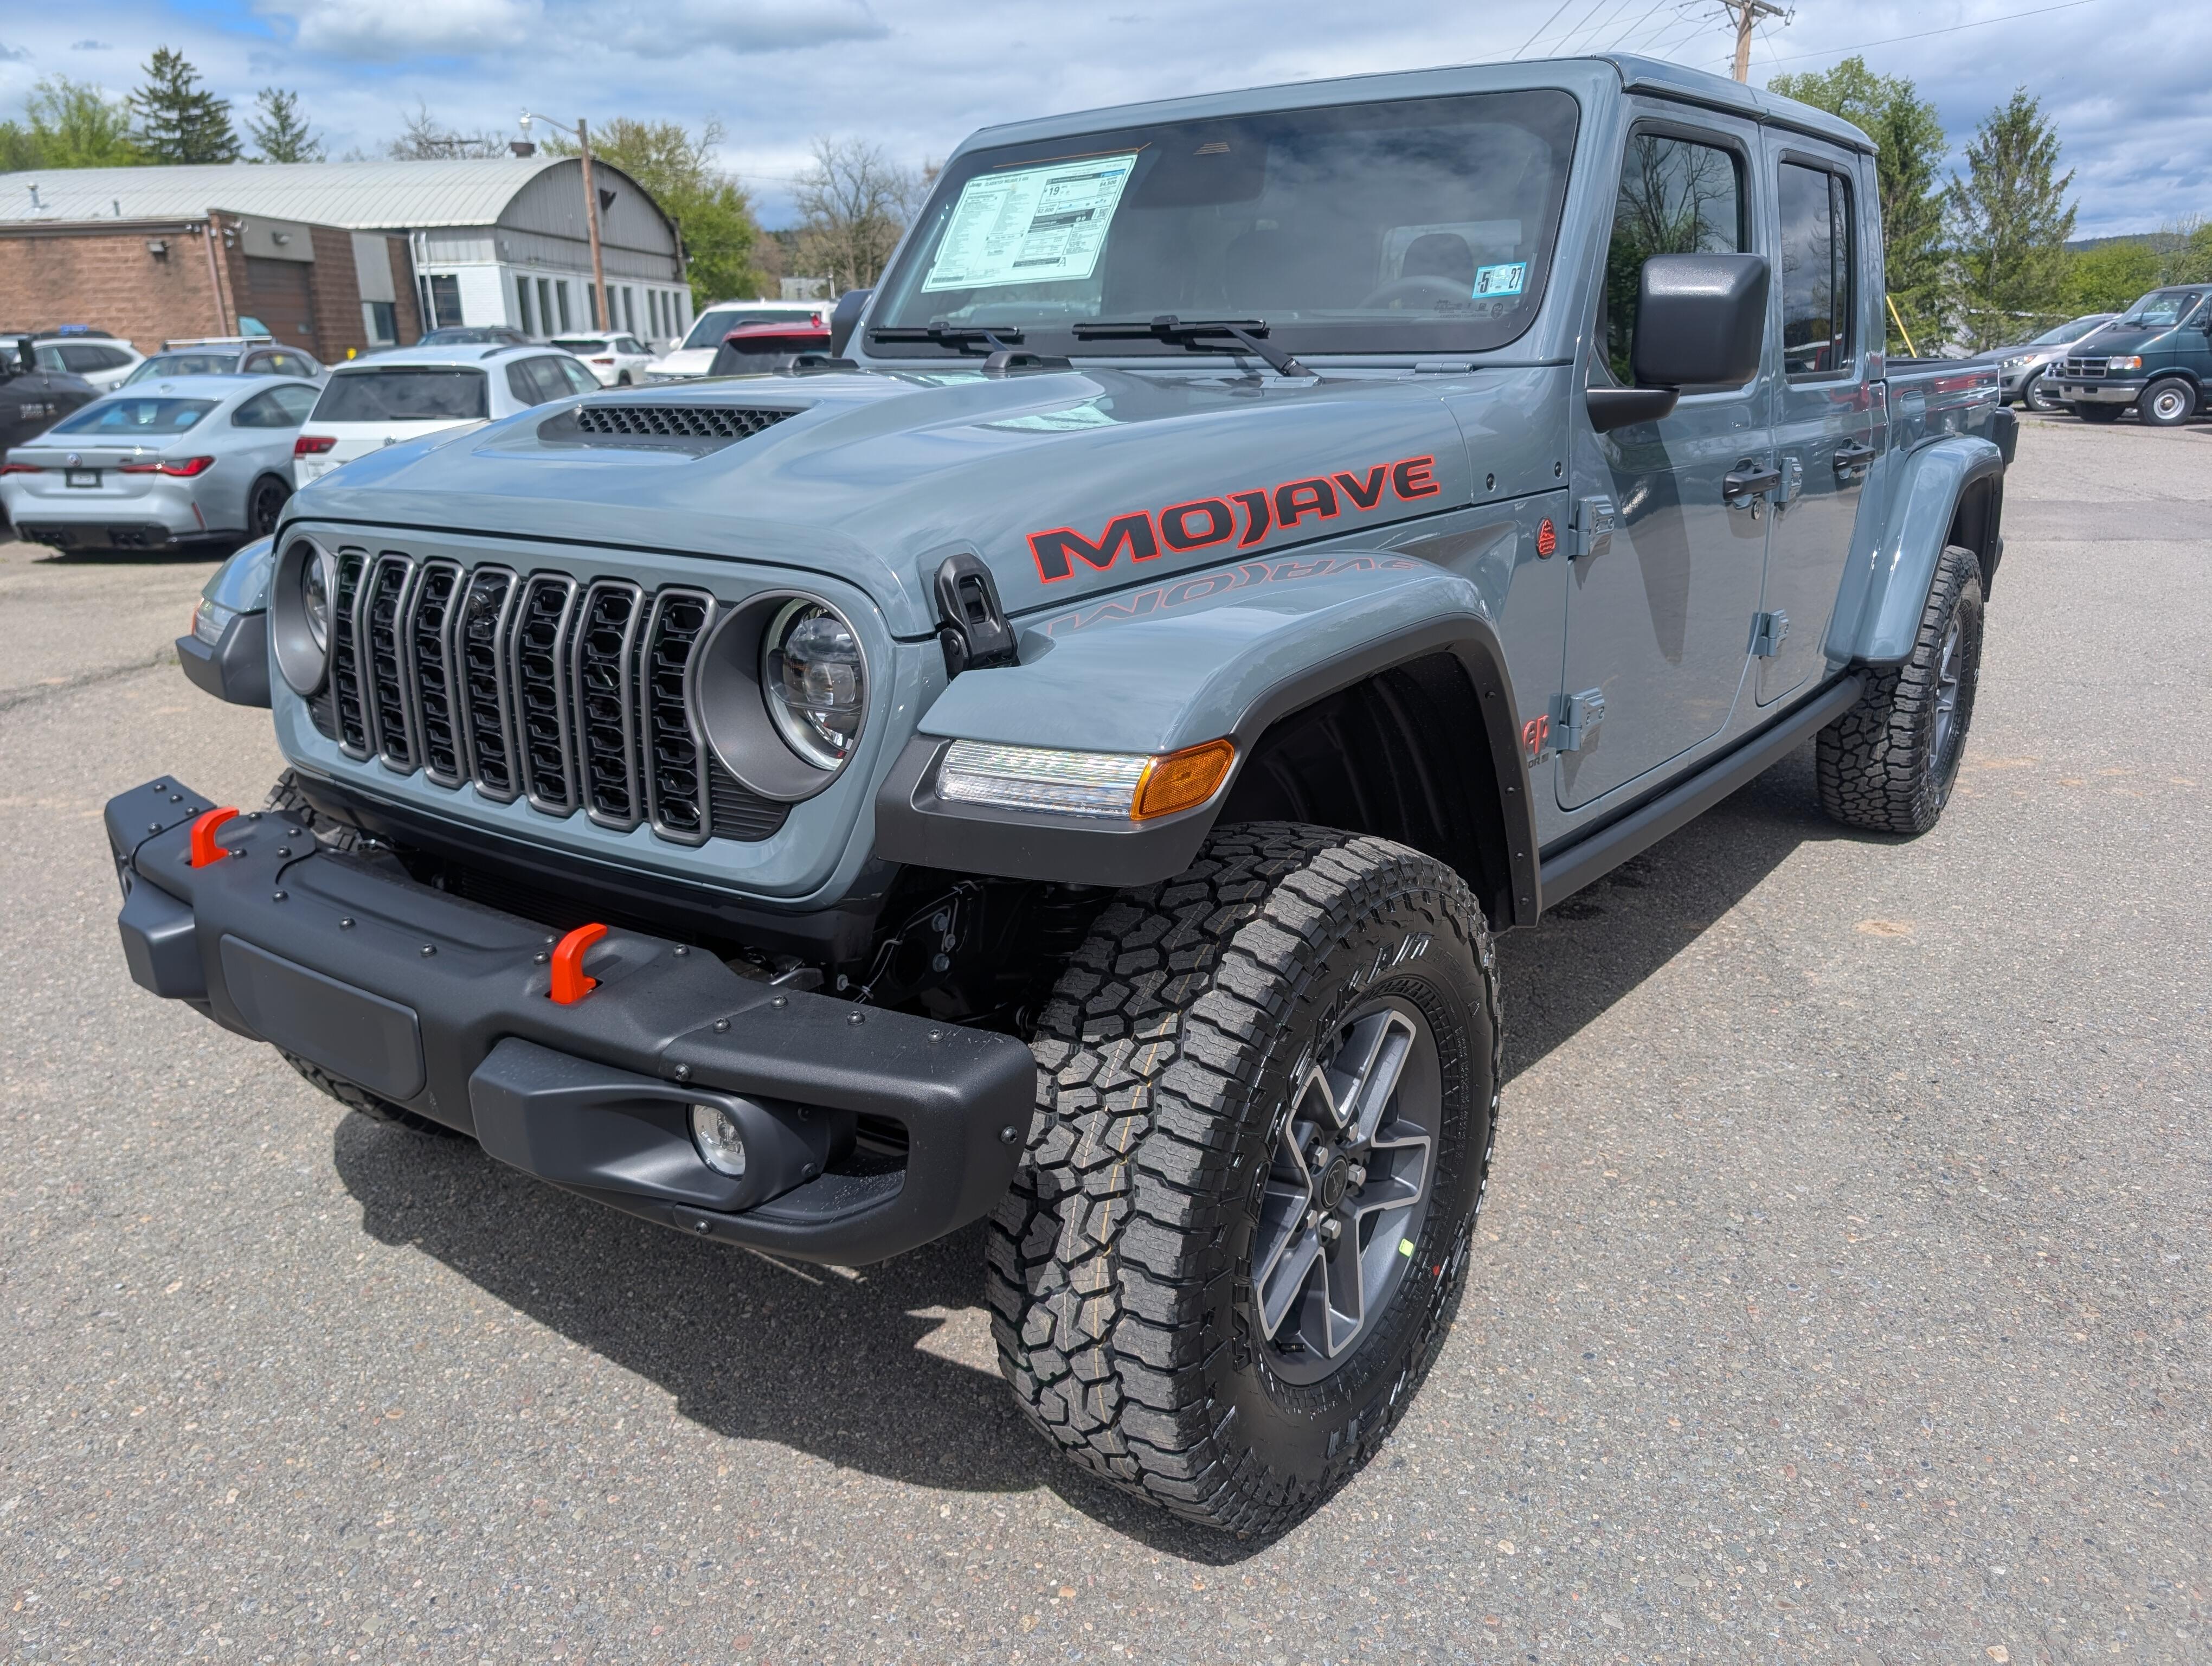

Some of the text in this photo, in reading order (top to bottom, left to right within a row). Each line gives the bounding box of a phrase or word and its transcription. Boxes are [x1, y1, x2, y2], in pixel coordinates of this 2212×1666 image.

[1049, 187, 1059, 196] 19
[1480, 271, 1490, 293] 5
[1508, 267, 1522, 290] 27
[1026, 454, 1441, 584] MOJAVE
